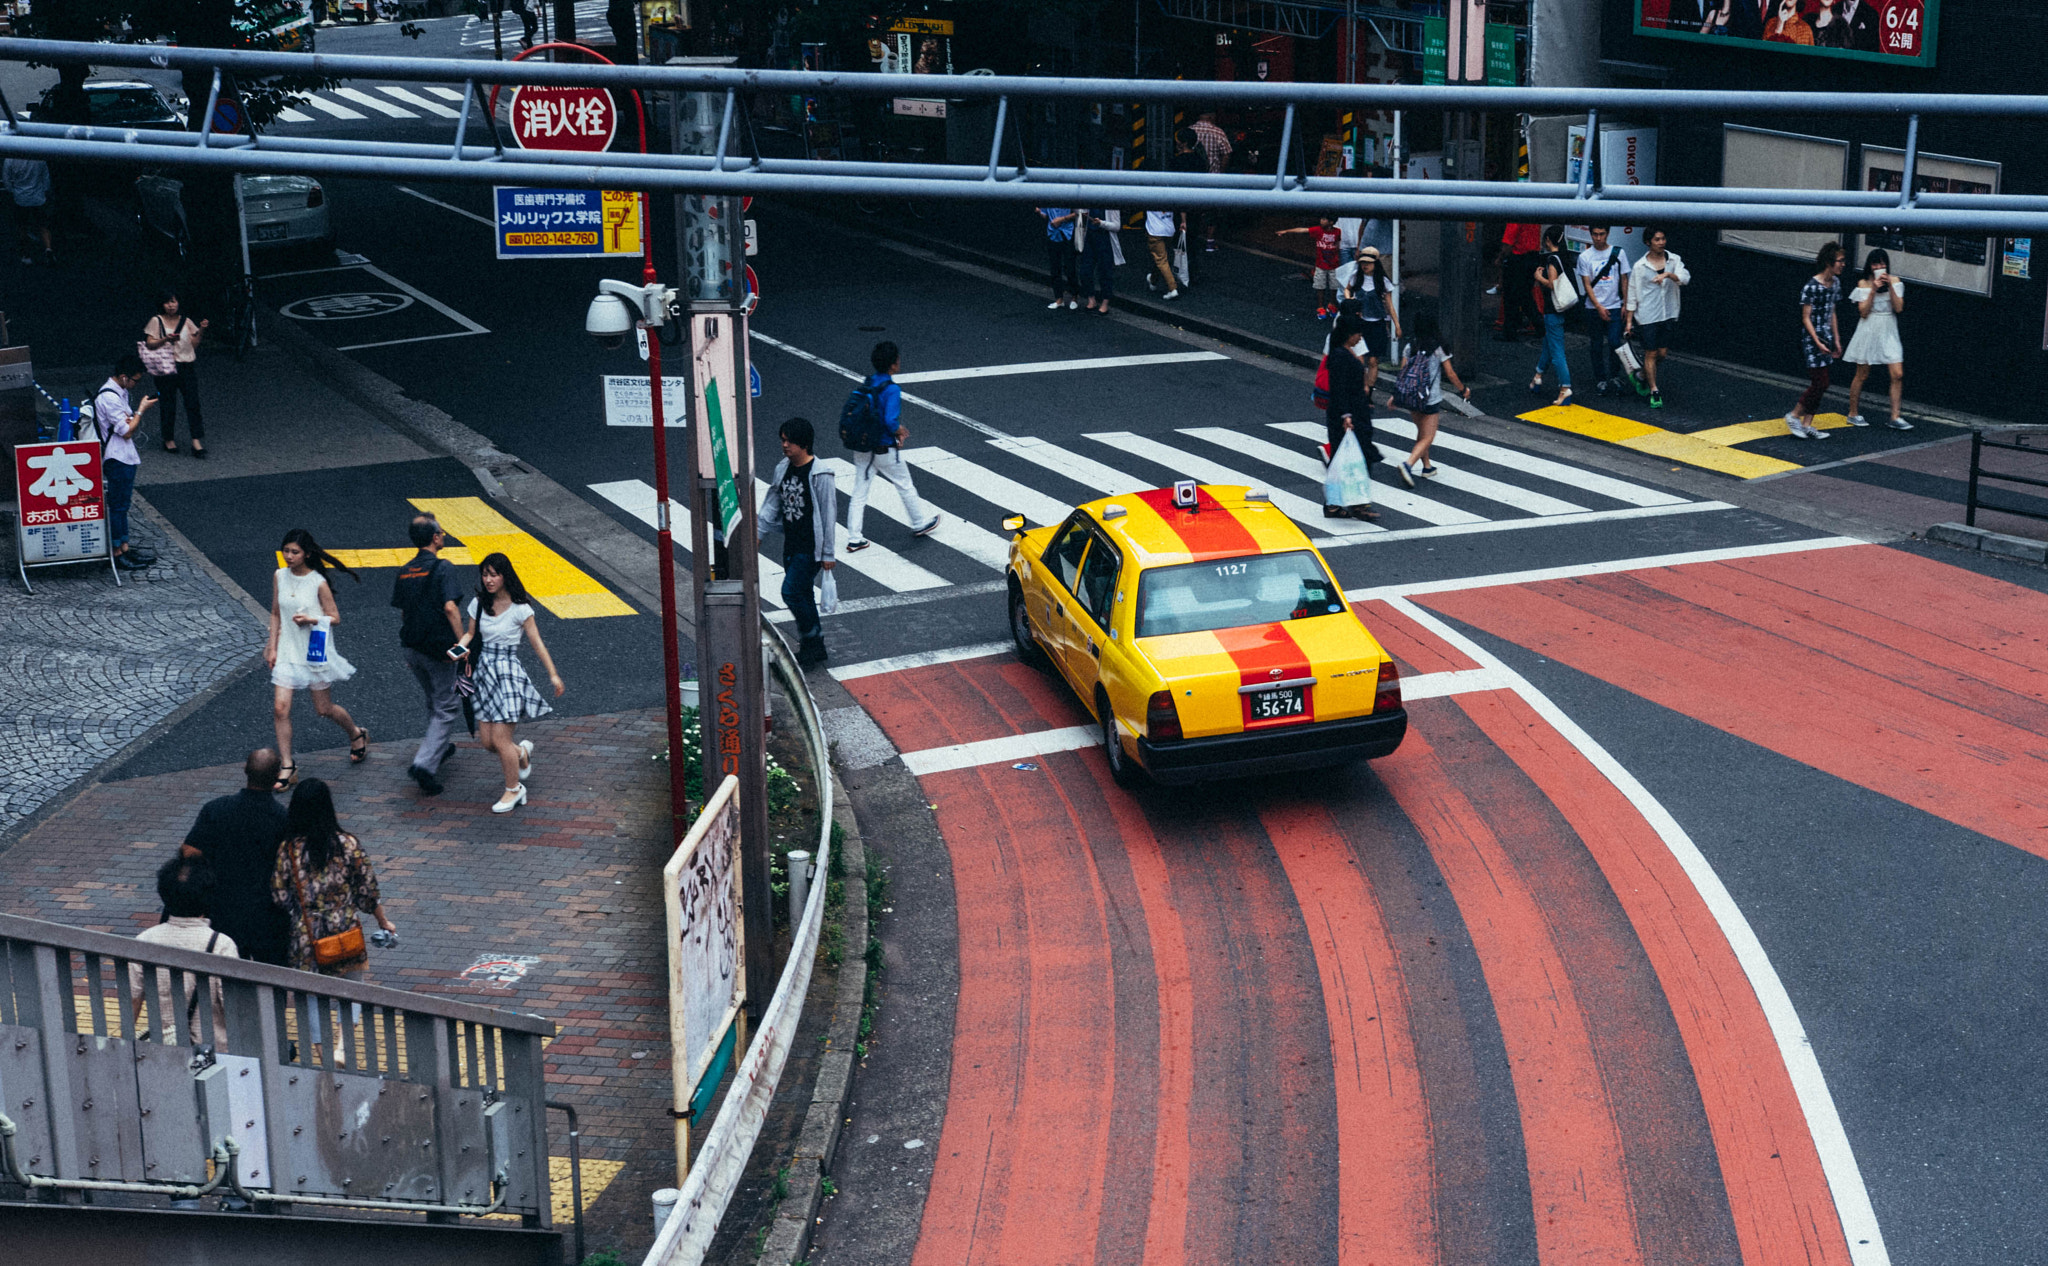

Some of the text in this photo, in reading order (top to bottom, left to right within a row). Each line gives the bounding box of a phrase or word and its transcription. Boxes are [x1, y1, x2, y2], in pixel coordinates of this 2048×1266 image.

[1886, 6, 1919, 31] 6/4
[1889, 32, 1913, 49] 公開
[521, 97, 606, 138] 消火栓
[514, 193, 586, 206] 医歯専門予備校
[603, 191, 634, 202] この先
[501, 211, 602, 226] メルリックス学院
[26, 447, 94, 506] 本
[26, 504, 99, 524] あおい書店
[27, 525, 79, 536] 2F 1F
[1215, 563, 1248, 577] 1127
[1279, 690, 1293, 699] 500
[1262, 697, 1302, 717] 56-74
[717, 662, 741, 776] さくら通り
